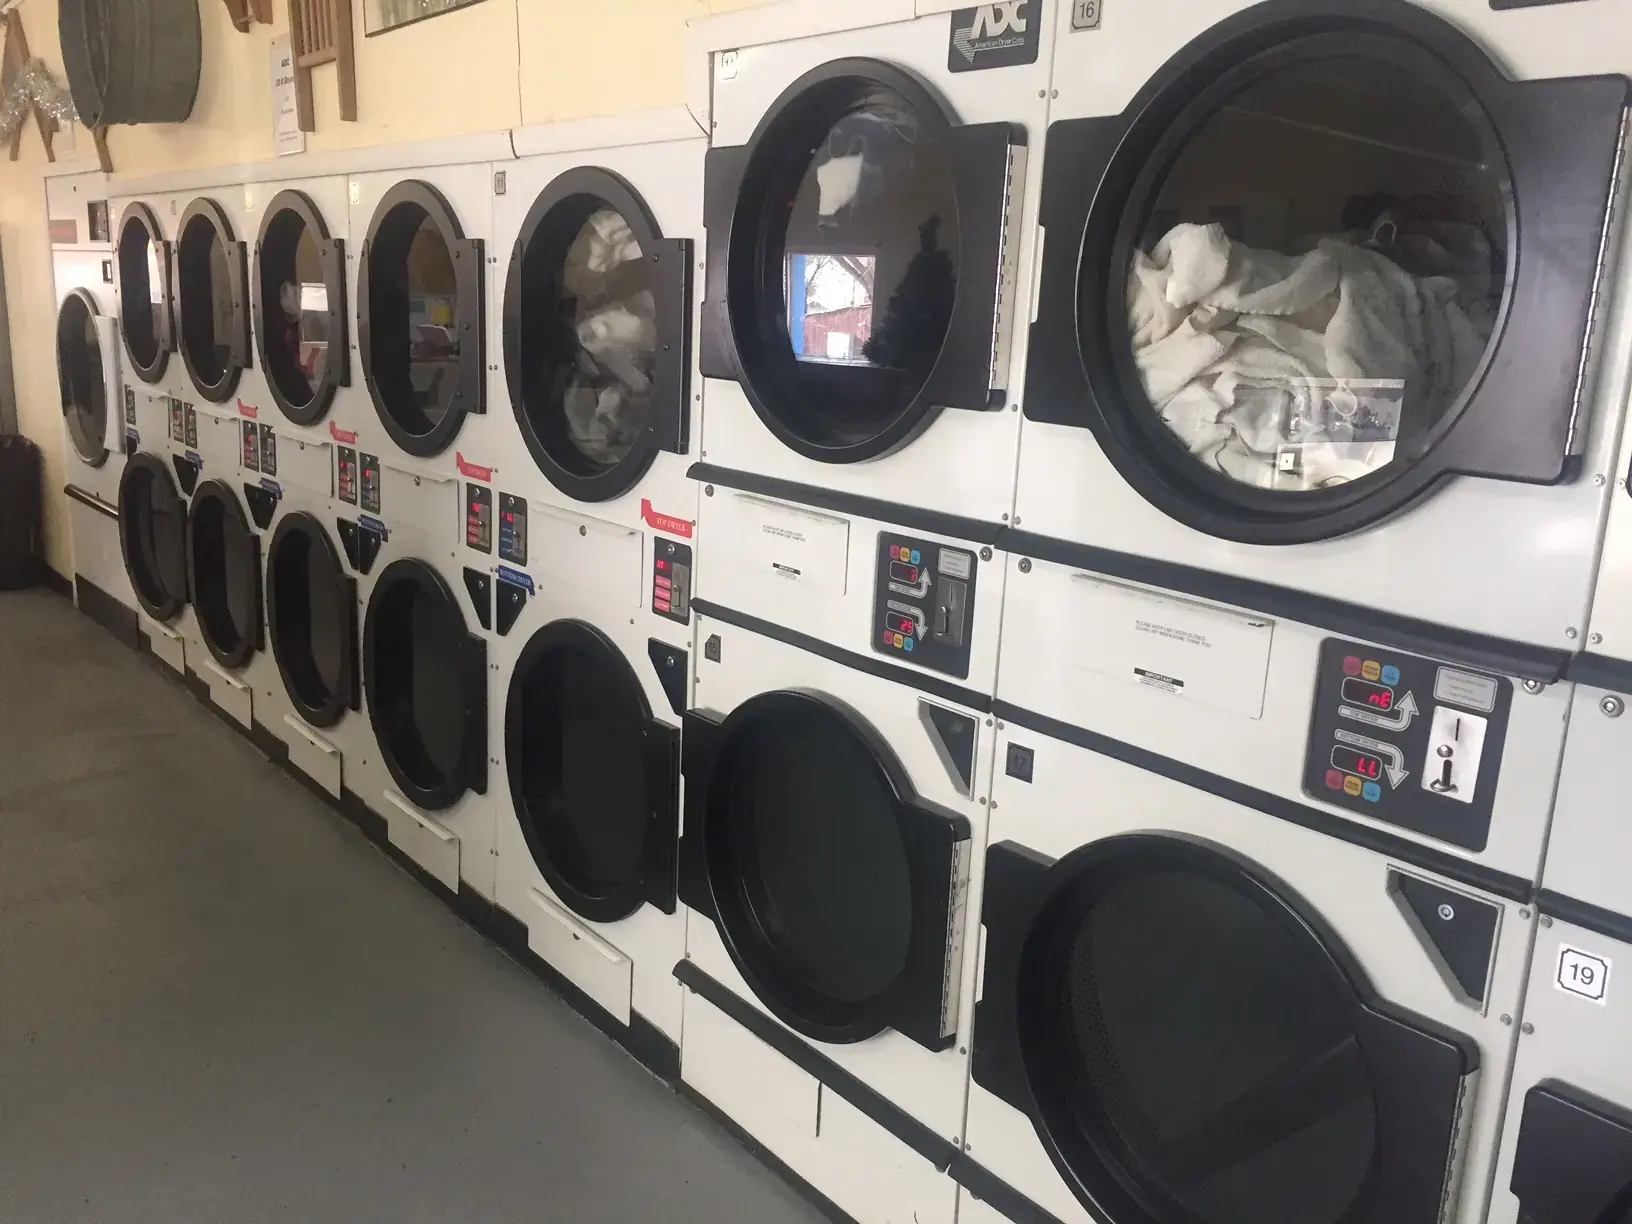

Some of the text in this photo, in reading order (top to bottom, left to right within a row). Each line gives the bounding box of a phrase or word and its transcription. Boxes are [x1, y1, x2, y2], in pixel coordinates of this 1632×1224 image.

[1080, 1, 1095, 19] 16
[975, 40, 999, 49] American
[999, 38, 1012, 47] Dryer
[657, 517, 686, 532] TOP DRYER
[1135, 620, 1151, 628] PLEASE
[1174, 629, 1187, 637] DOOR
[1187, 632, 1206, 641] CLOSED
[709, 642, 717, 654] 15
[1144, 671, 1174, 684] IMPORTANT
[1570, 963, 1595, 985] 19
